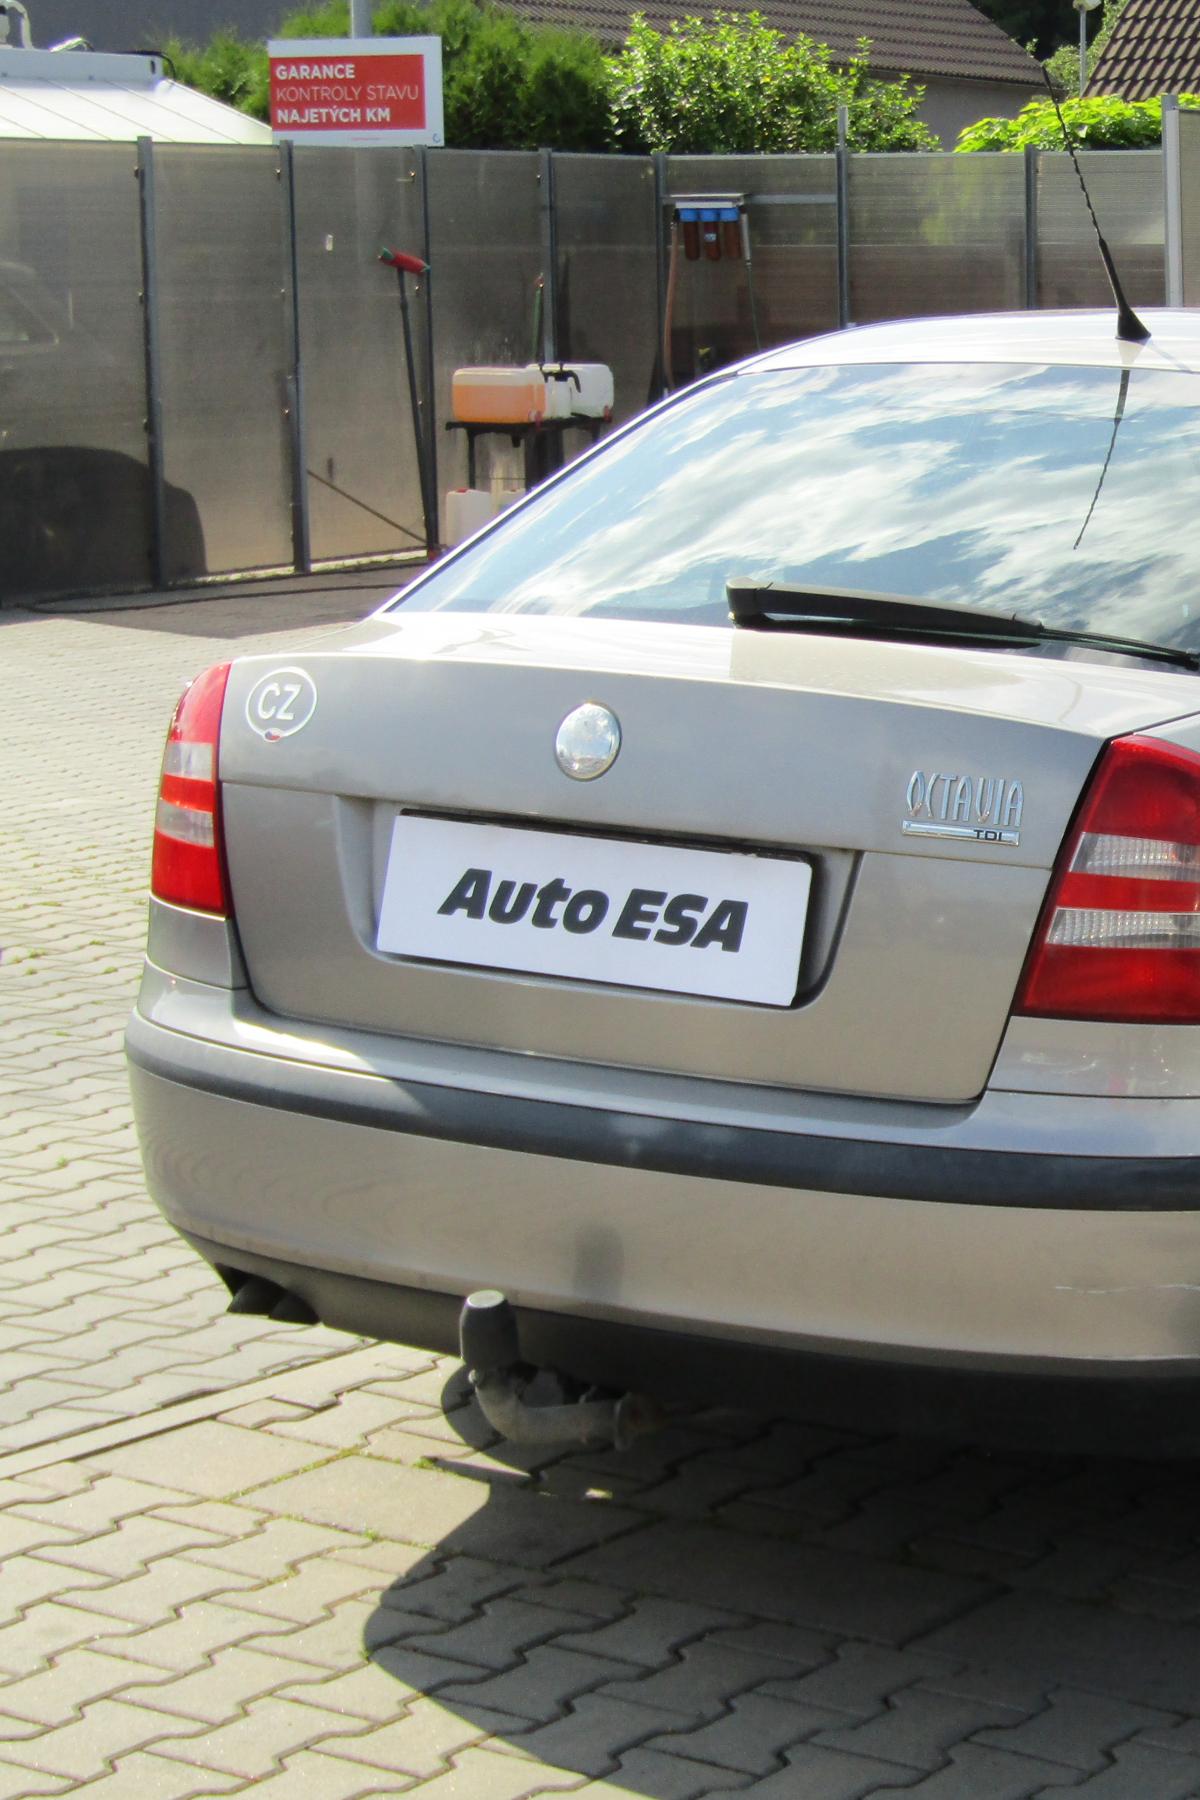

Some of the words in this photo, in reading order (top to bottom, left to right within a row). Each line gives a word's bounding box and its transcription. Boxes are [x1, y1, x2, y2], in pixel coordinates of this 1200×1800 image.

[275, 64, 355, 80] GARANCE
[276, 86, 361, 101] KONTROLY
[366, 85, 419, 100] STAVU
[277, 106, 361, 123] NAJETÝCH
[365, 108, 390, 122] KM
[257, 682, 302, 721] CZ
[906, 770, 1024, 826] OCTAVIA
[974, 830, 1003, 841] TDI
[436, 867, 610, 935] Auto
[611, 887, 750, 953] ESA
